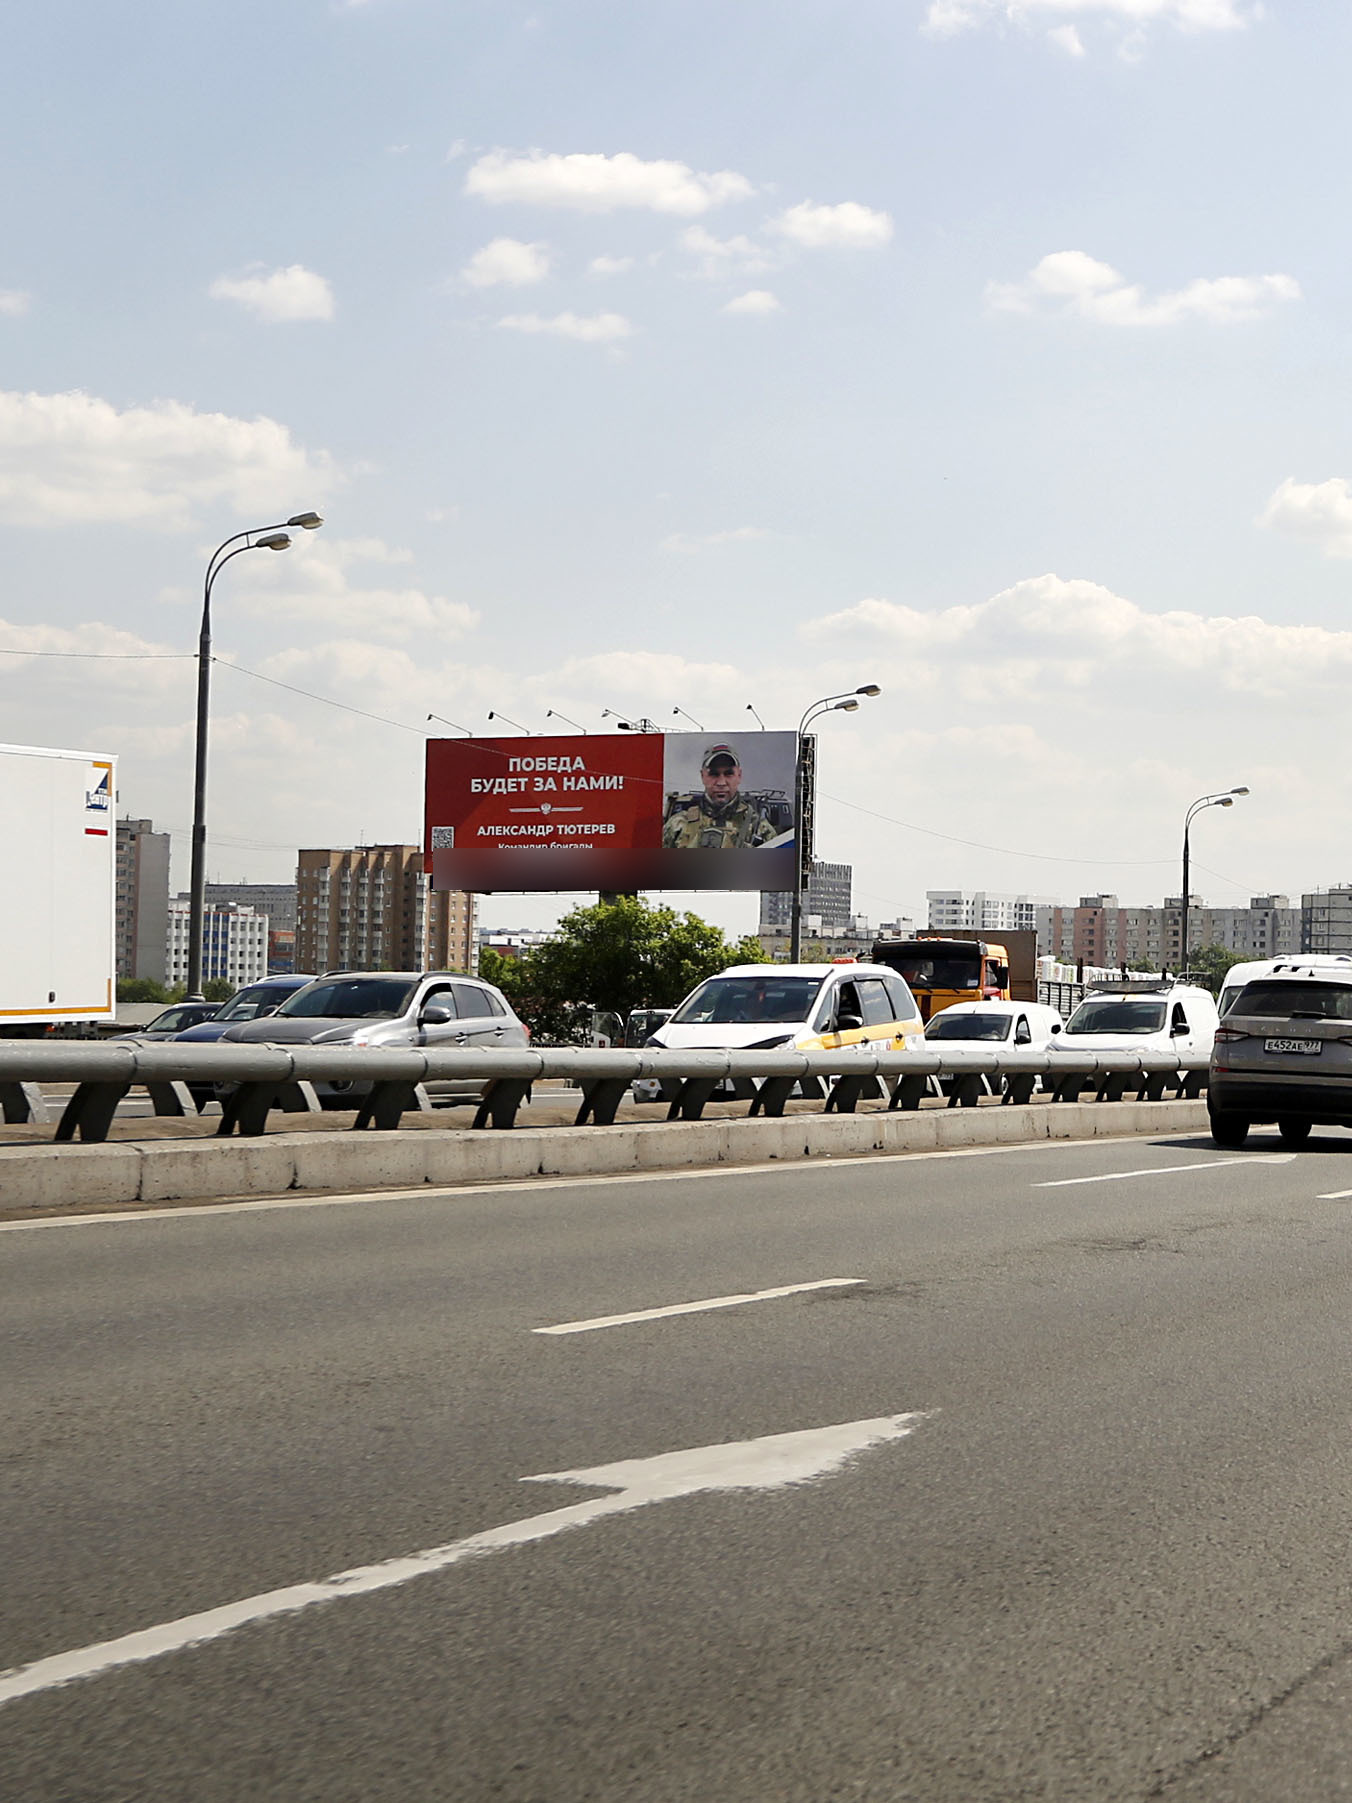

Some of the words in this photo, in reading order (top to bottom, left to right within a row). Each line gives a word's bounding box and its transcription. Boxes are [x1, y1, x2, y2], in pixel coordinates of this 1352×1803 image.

[508, 756, 586, 773] ПОБЕДА
[470, 777, 529, 794] БУДЕТ
[533, 776, 558, 791] ЗА
[563, 775, 625, 791] НАМИ!
[476, 825, 554, 836] АЛЕКСАНДР
[556, 823, 616, 835] ТЮТЕРЕВ
